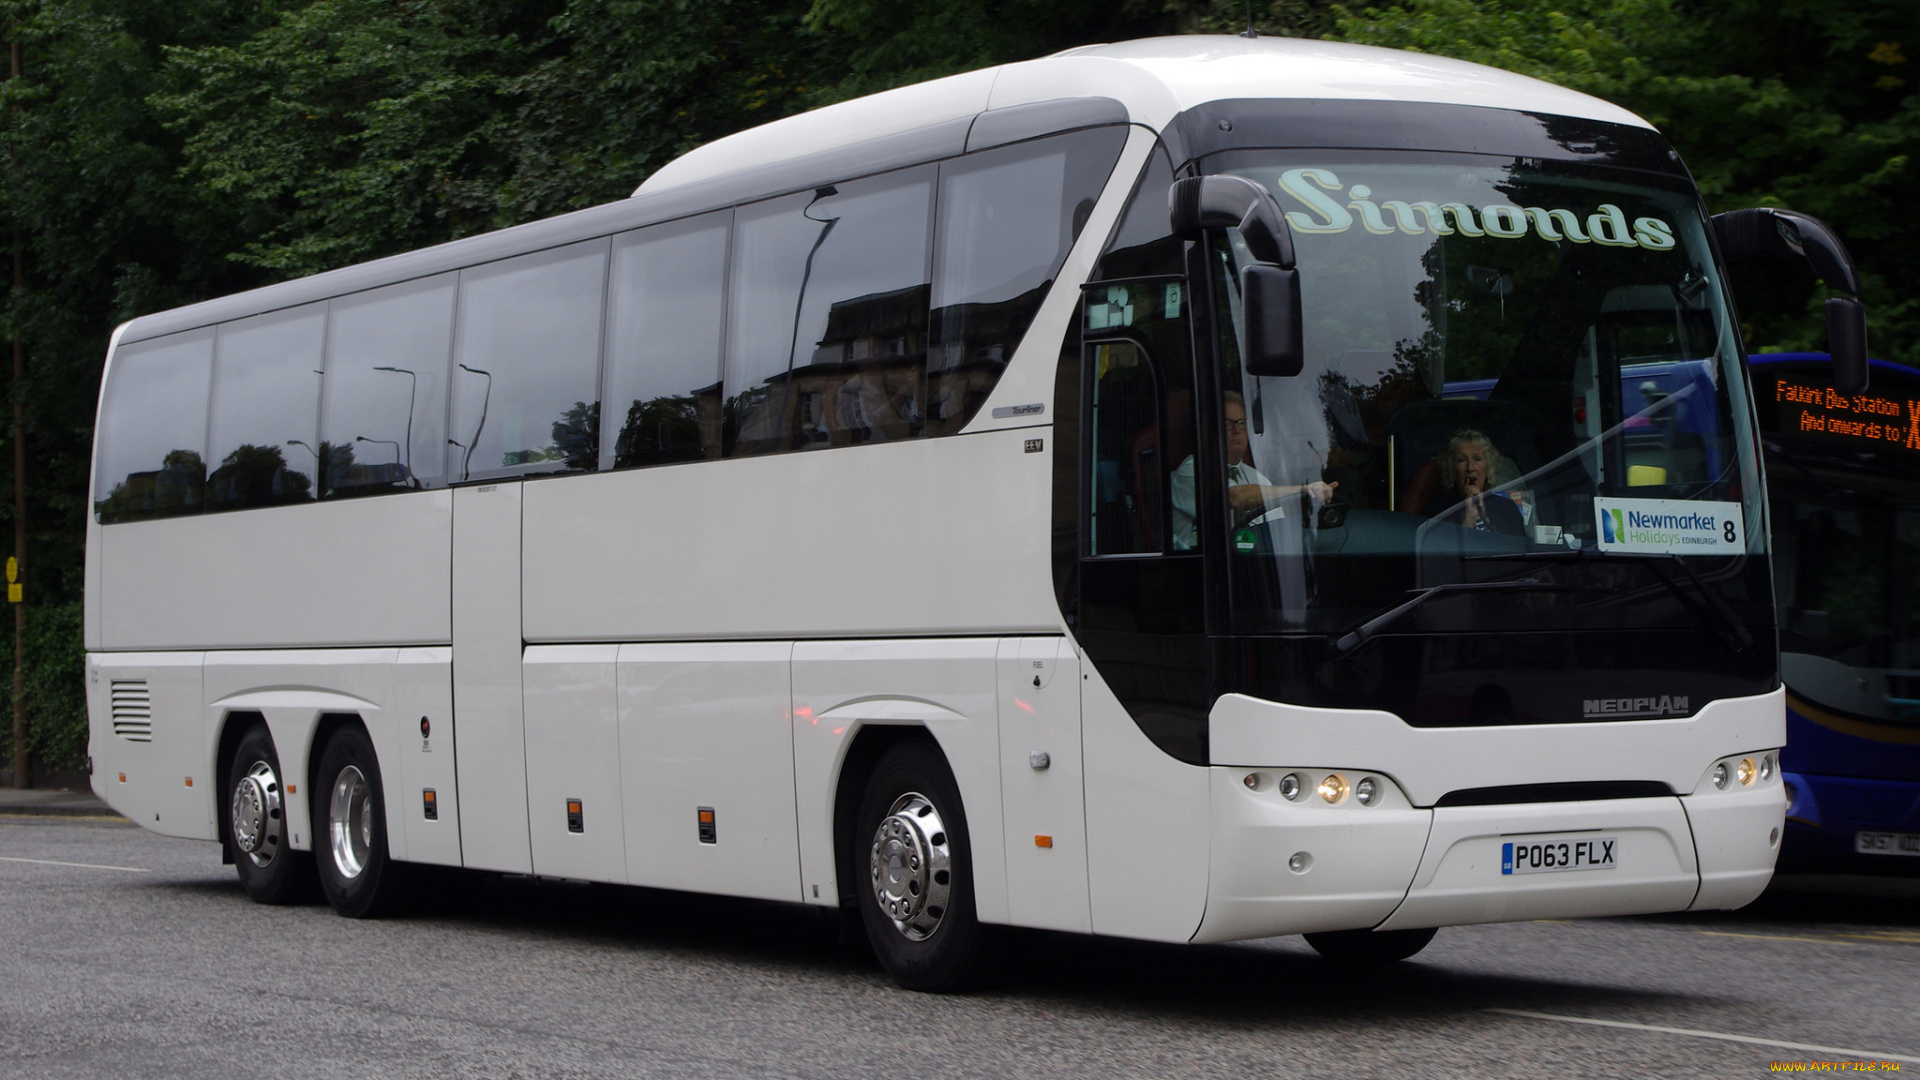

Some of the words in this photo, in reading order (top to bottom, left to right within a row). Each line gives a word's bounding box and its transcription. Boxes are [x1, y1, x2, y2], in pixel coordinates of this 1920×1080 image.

[1278, 168, 1676, 250] Simonds
[1776, 380, 1823, 405] Falkirk
[1825, 387, 1850, 409] Bus
[1852, 394, 1900, 416] Station
[1800, 409, 1825, 431] And
[1827, 418, 1882, 439] onwards
[1025, 440, 1042, 451] EEV
[1628, 510, 1717, 531] Newmarket
[1723, 520, 1737, 543] 8
[1630, 530, 1681, 546] Holidays
[1681, 536, 1718, 545] EDINBURGH
[1583, 695, 1689, 717] NEOPLAN
[1575, 840, 1614, 866] FLX
